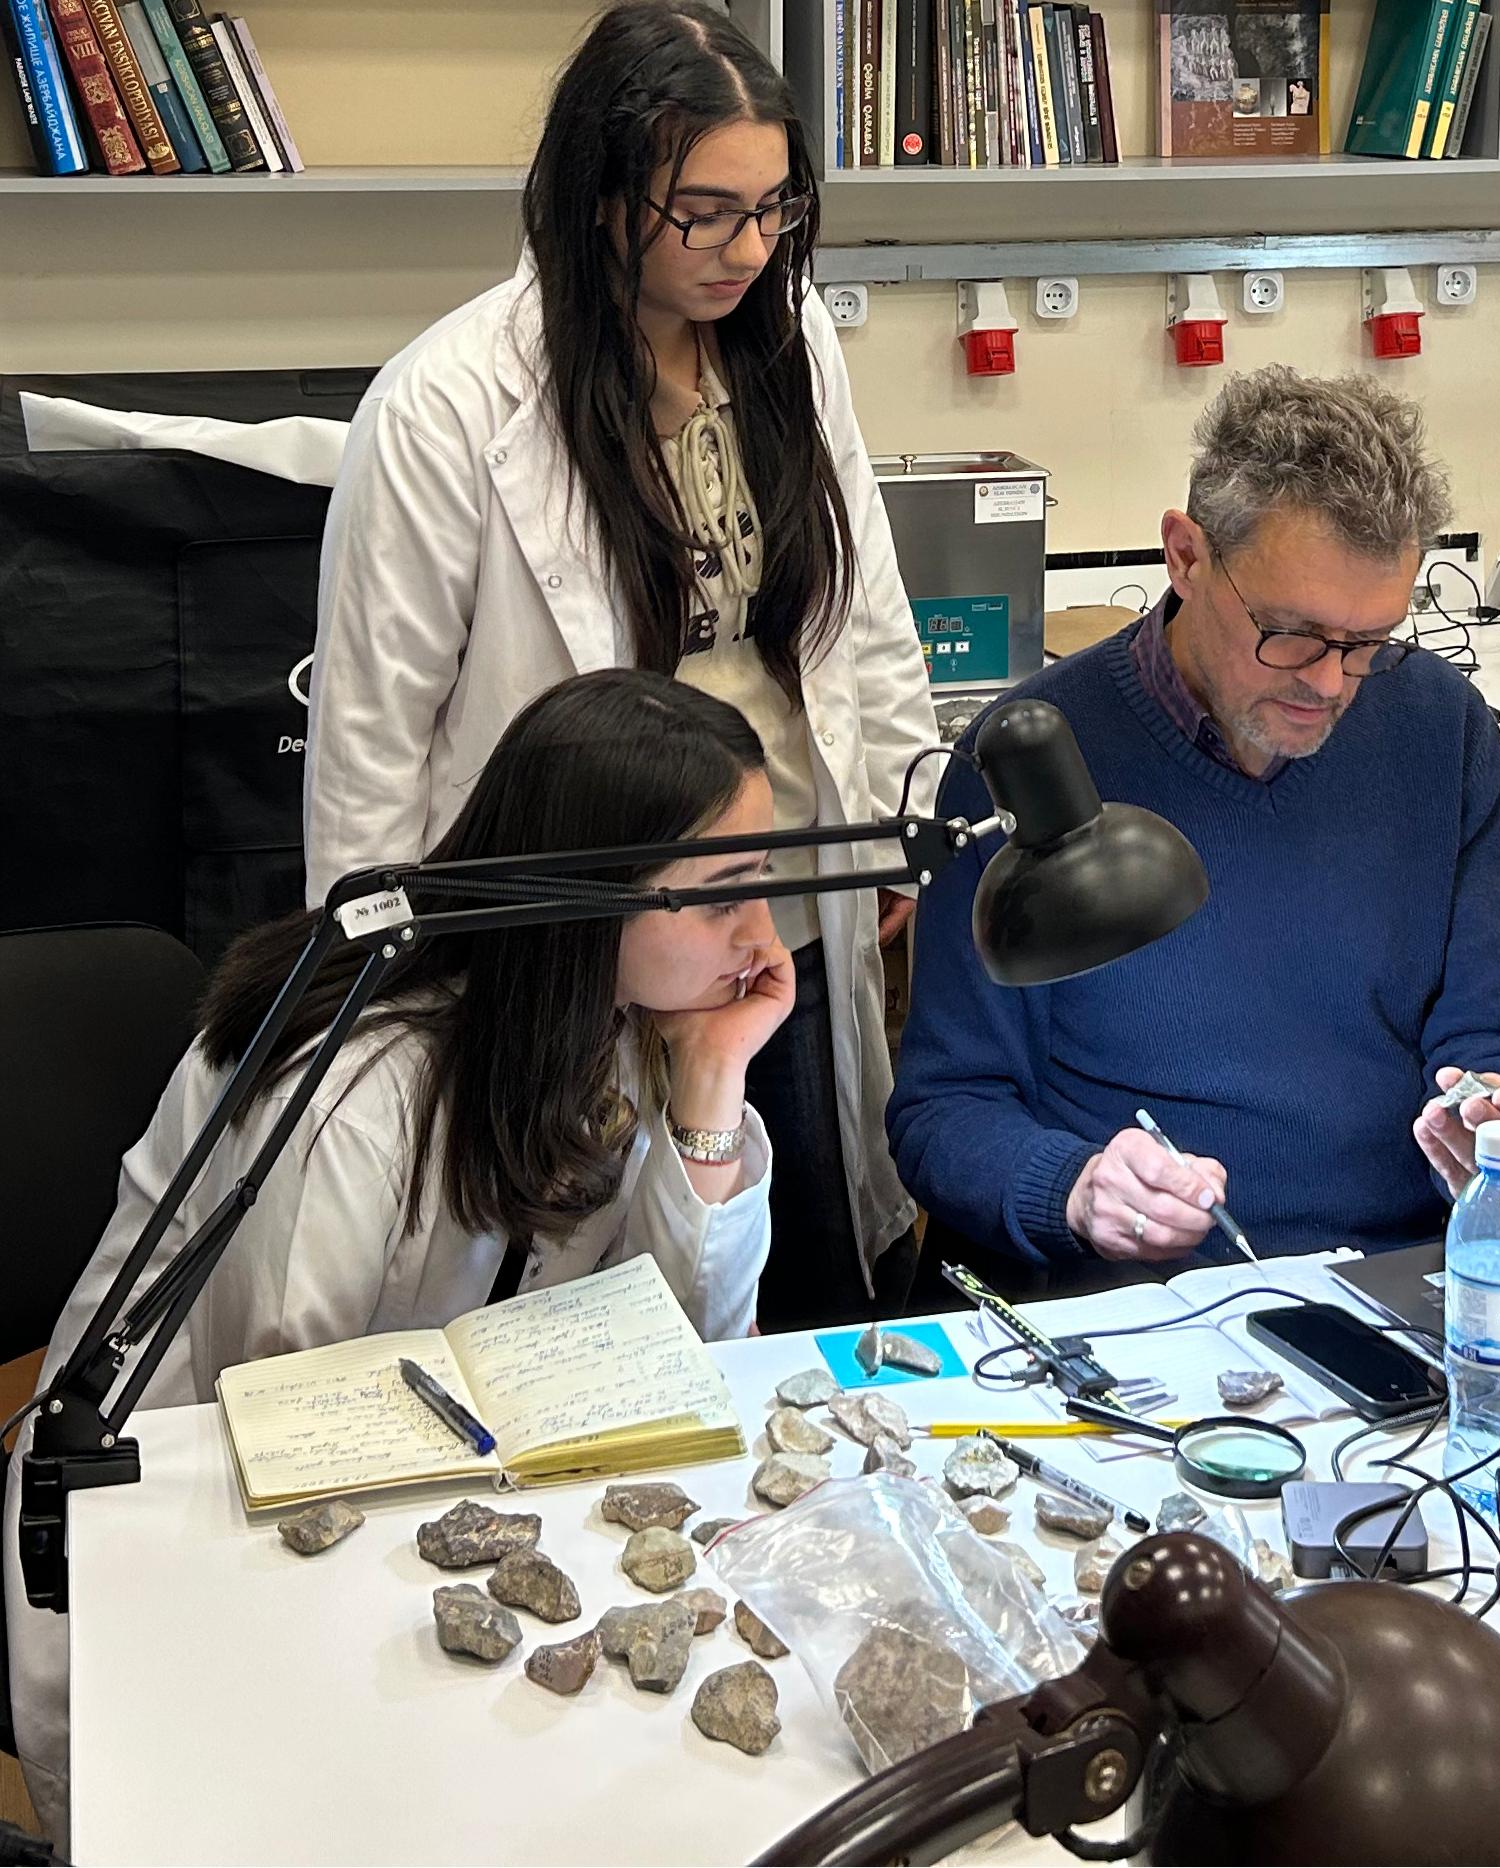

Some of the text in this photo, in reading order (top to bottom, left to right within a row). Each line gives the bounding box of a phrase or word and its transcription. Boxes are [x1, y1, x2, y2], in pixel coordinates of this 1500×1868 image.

[70, 40, 98, 60] VIII
[21, 14, 42, 67] ЖИЛИЩЕ
[35, 69, 66, 160] АЗЕРБАЙДЖАНА
[109, 41, 160, 141] ENSİKLOPEDİYASI
[863, 63, 874, 100] QƏDİM
[863, 105, 874, 155] QARABAĞ
[372, 897, 401, 913] 1002
